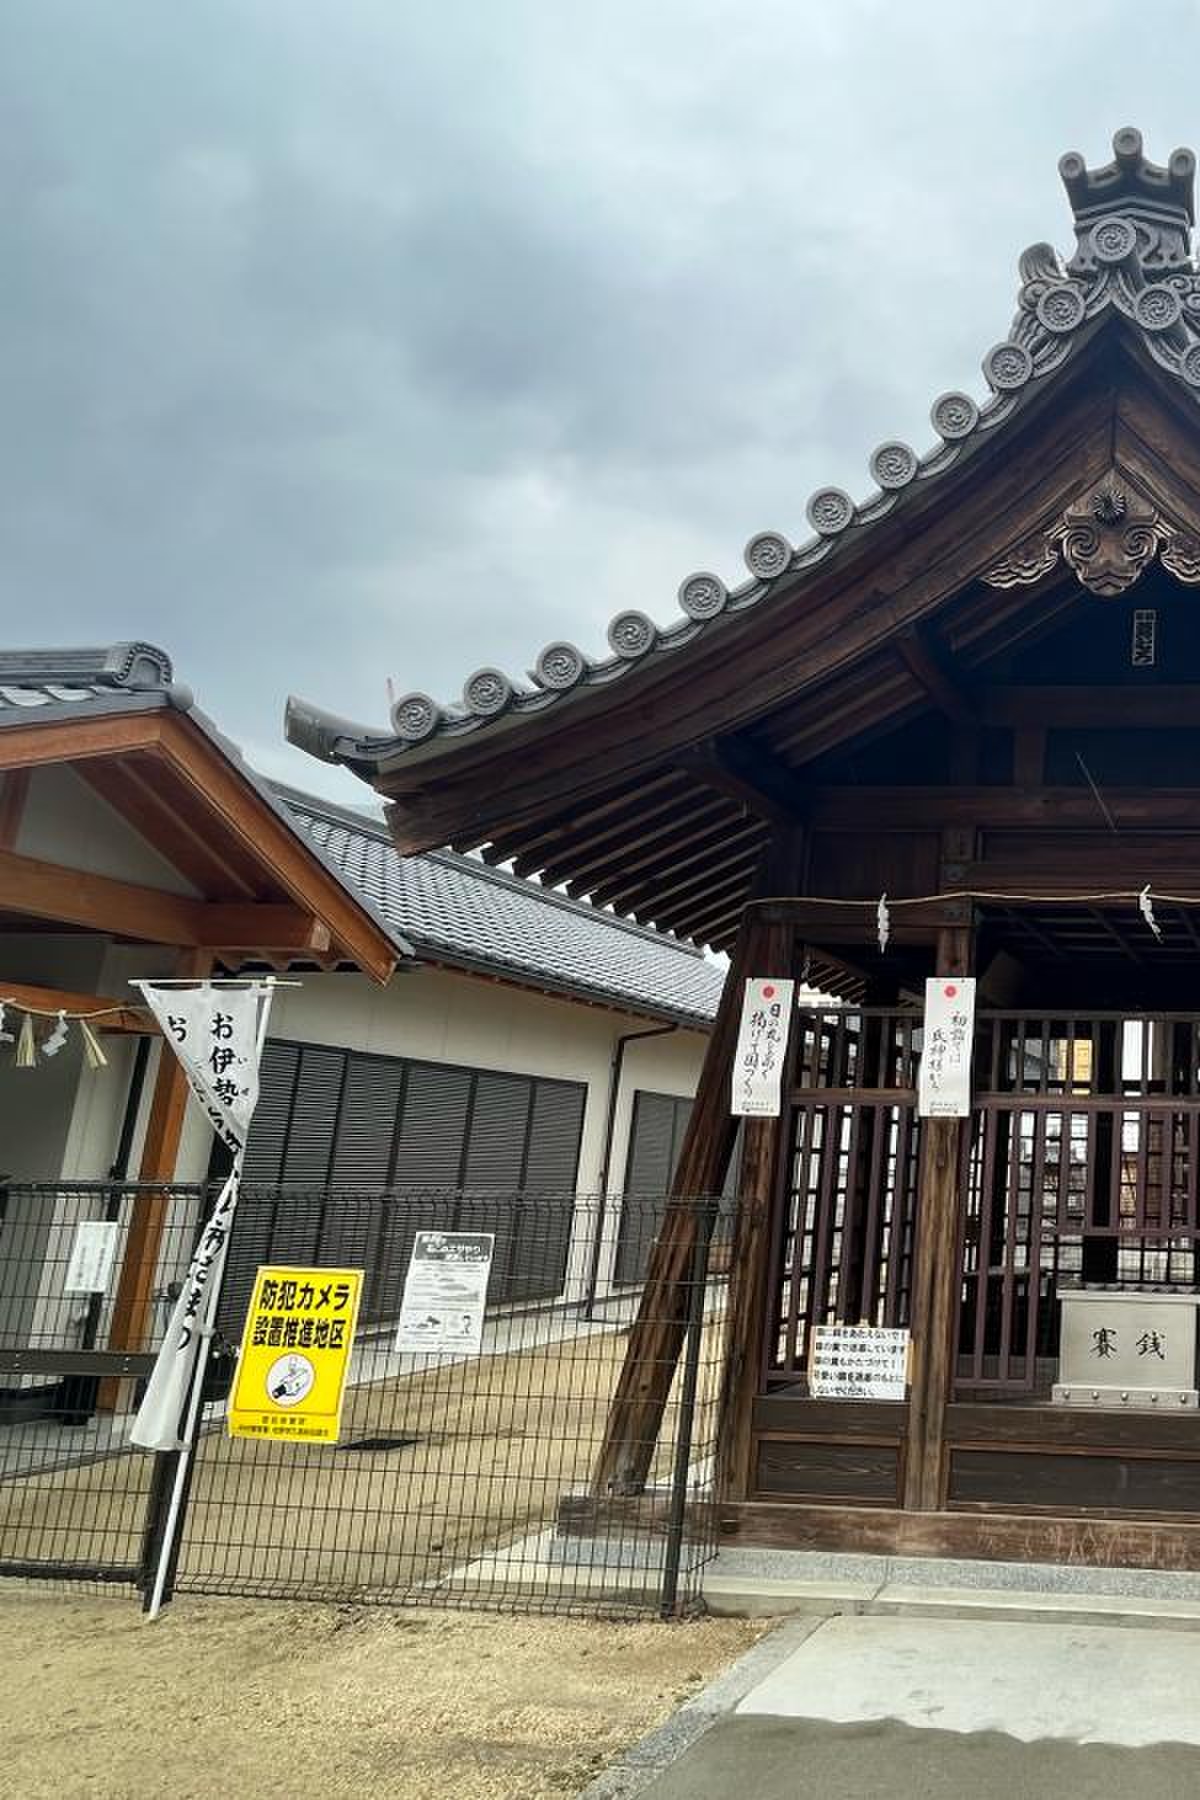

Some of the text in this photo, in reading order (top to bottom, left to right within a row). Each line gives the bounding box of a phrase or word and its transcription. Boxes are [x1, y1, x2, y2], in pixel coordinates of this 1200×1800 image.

[259, 1279, 349, 1311] 防犯カメラ
[252, 1315, 346, 1349] 設置推進地区
[1089, 1328, 1166, 1360] 賽銭
